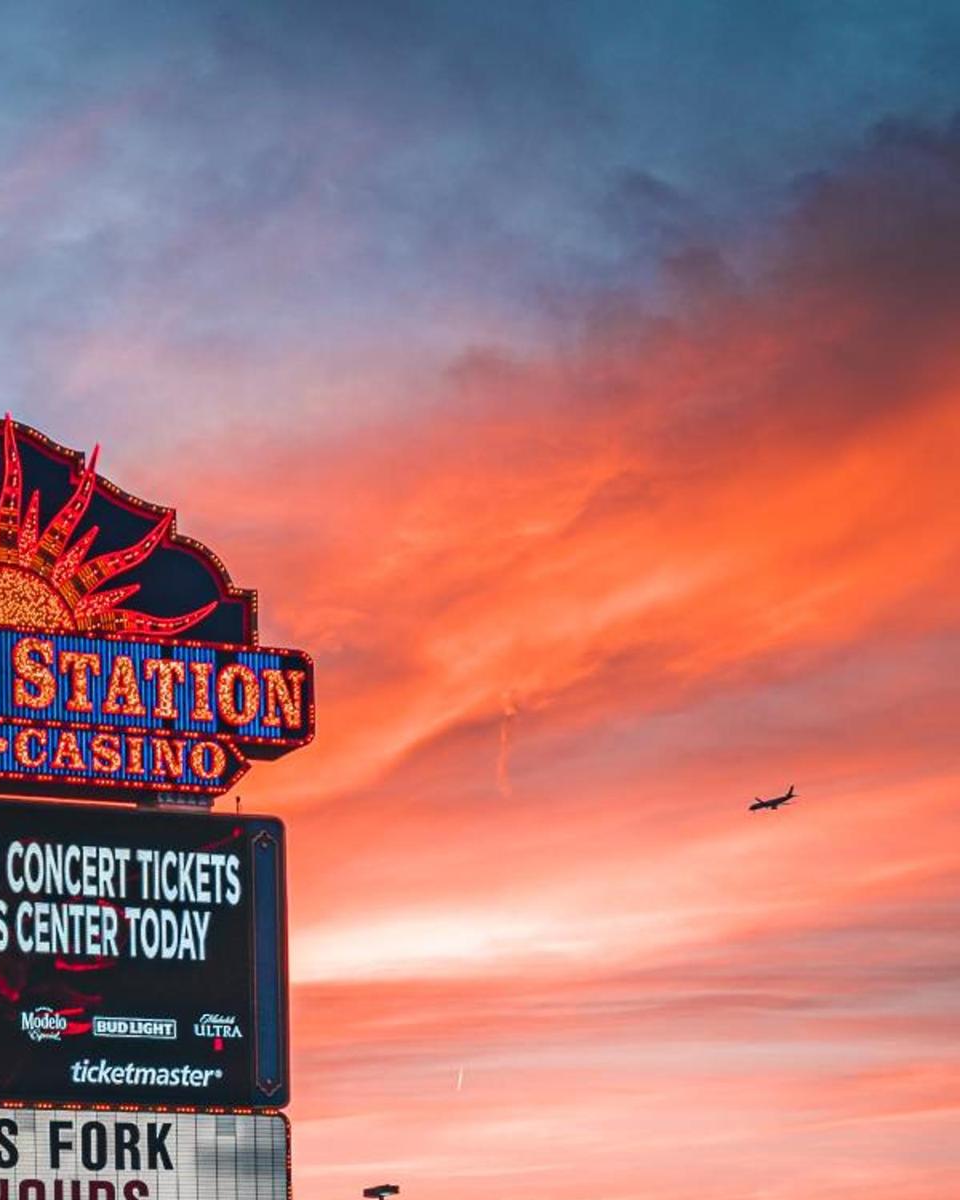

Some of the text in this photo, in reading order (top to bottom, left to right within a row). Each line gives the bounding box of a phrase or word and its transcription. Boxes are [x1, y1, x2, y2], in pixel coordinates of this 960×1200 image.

[12, 637, 306, 729] STATION
[14, 727, 227, 779] CASINO
[6, 840, 131, 899] CONCERT
[136, 849, 242, 906] TICKETS
[16, 900, 119, 957] CENTER
[123, 906, 212, 961] TODAY
[21, 1011, 67, 1031] Modelo
[96, 1020, 174, 1036] BUD LIGHT
[193, 1023, 244, 1038] ULTRA
[70, 1058, 216, 1087] ticketmaster
[50, 1120, 175, 1172] FORK
